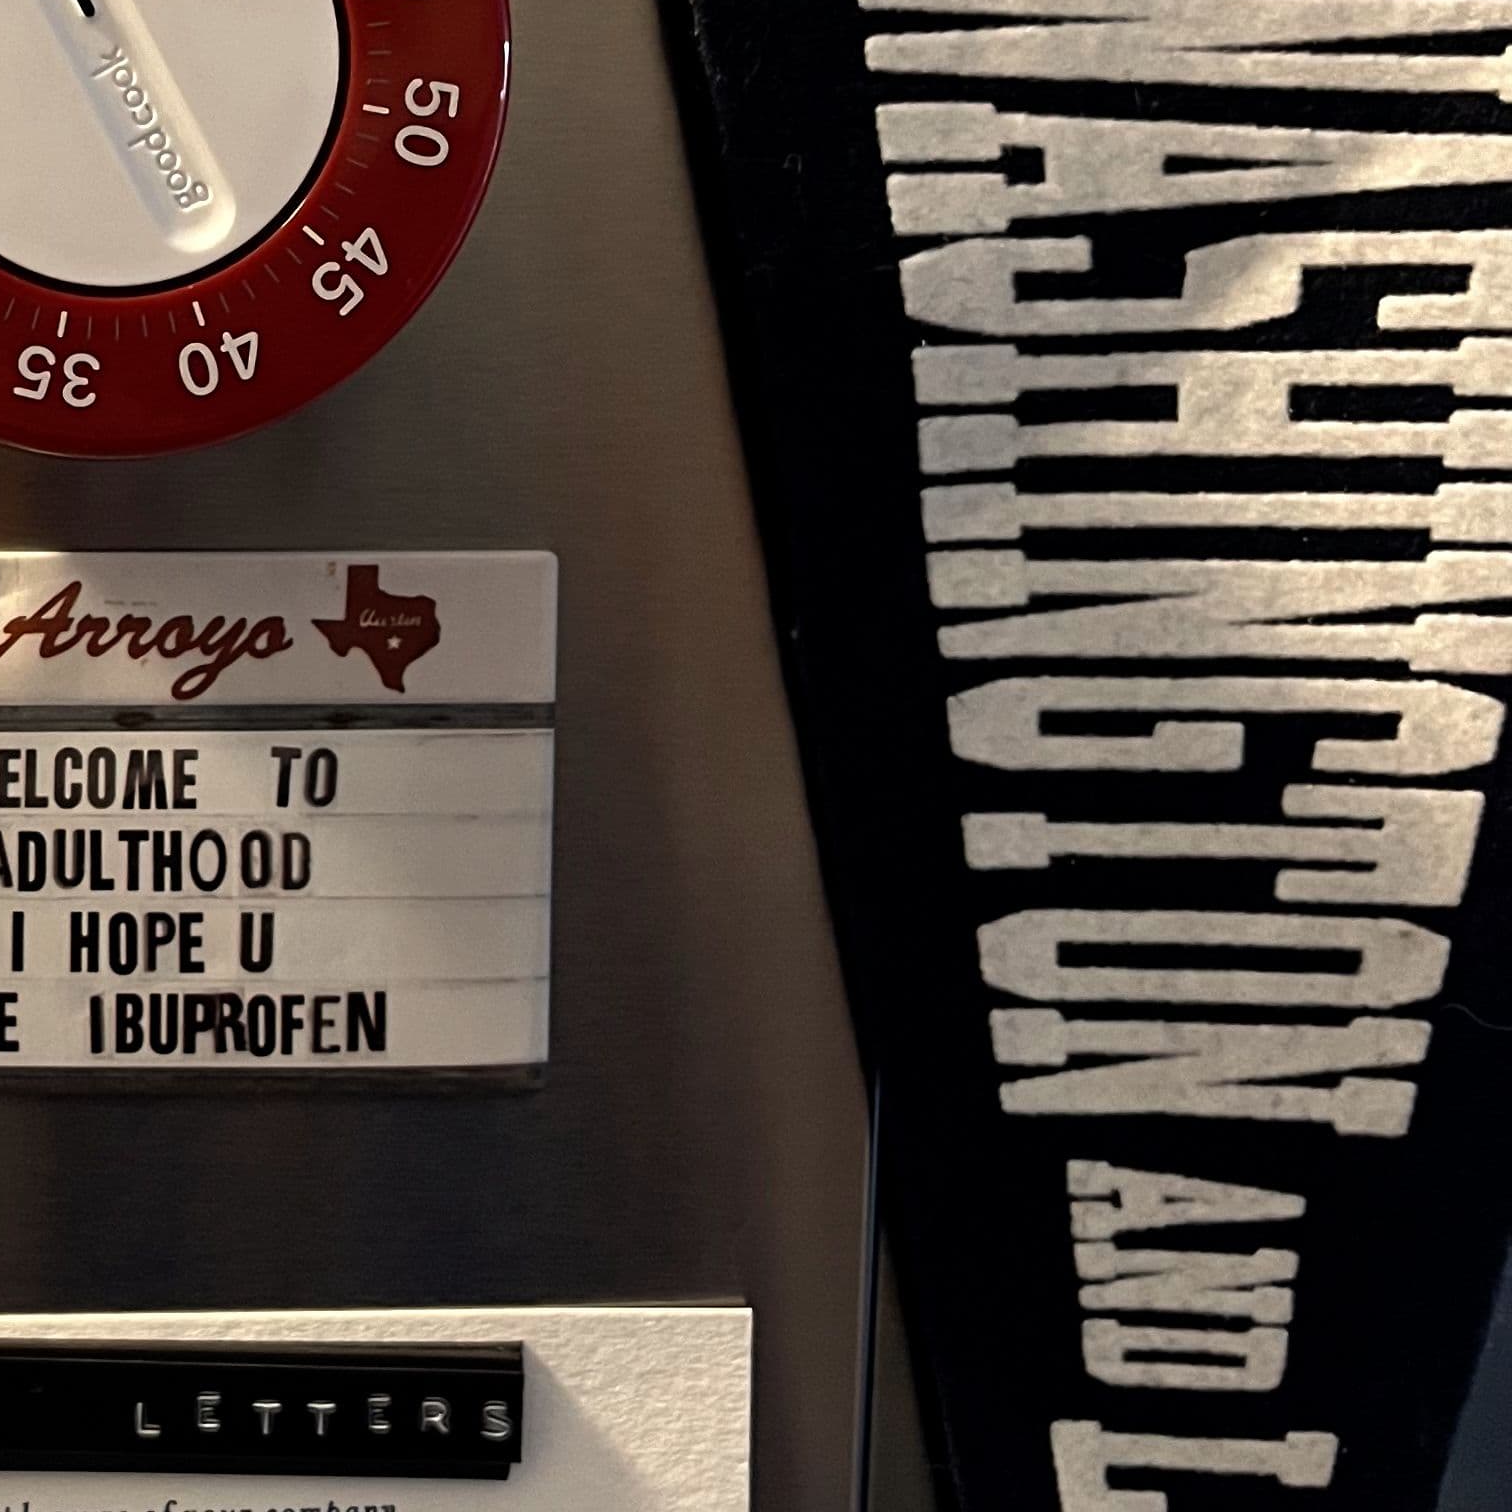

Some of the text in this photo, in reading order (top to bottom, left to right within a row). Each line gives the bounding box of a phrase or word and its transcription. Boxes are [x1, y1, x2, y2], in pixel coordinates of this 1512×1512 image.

[90, 45, 214, 213] goodcook
[395, 77, 460, 167] 50
[311, 226, 389, 318] 45
[13, 344, 101, 408] 35
[178, 330, 260, 396] 40
[271, 747, 339, 808] TO
[11, 910, 275, 976] I HOPE U
[88, 990, 388, 1057] IBUPROFEN
[1065, 1158, 1308, 1391] AND
[135, 1390, 512, 1441] LETTERS
